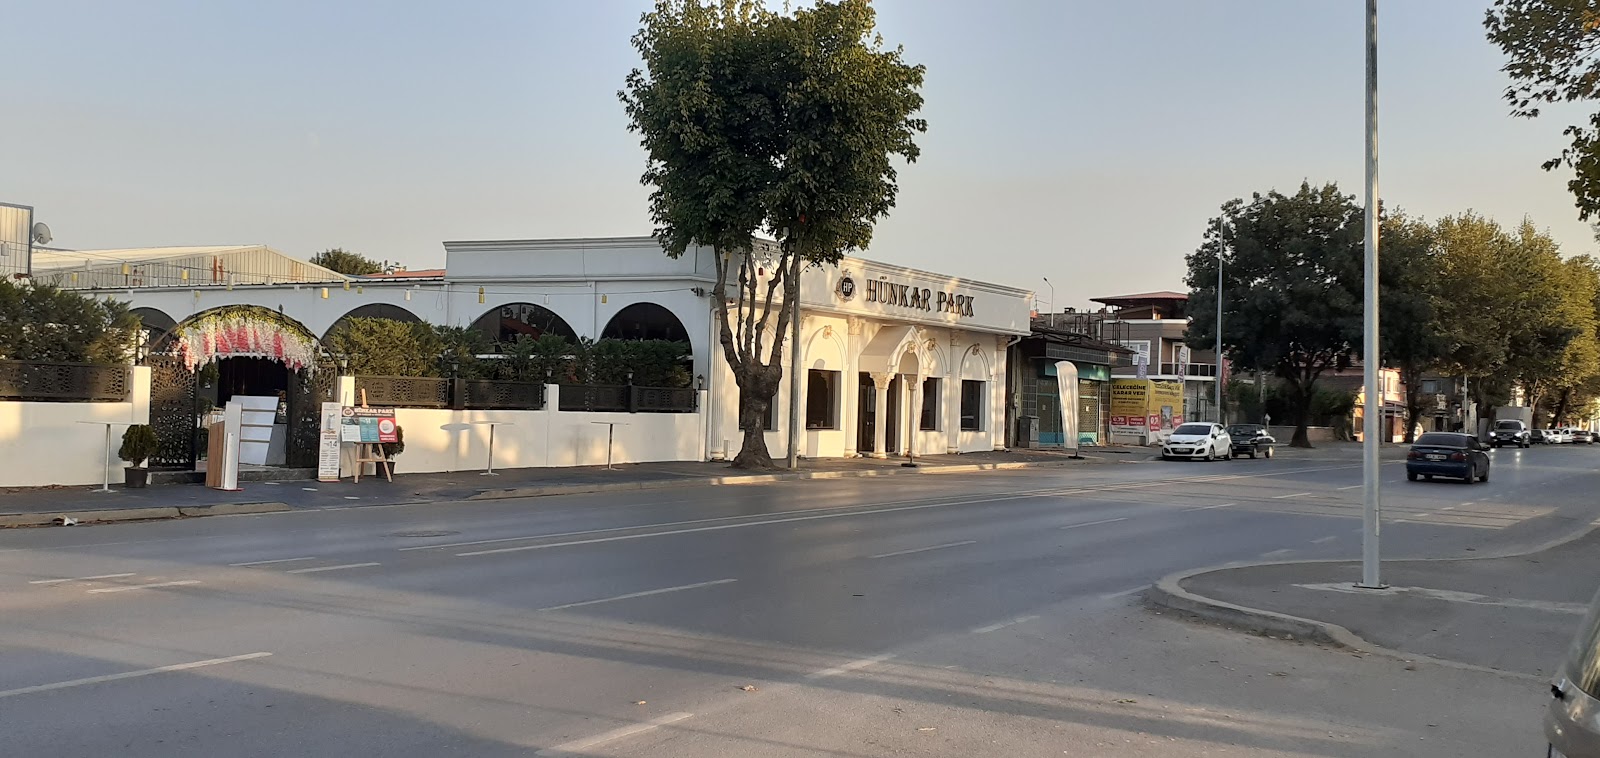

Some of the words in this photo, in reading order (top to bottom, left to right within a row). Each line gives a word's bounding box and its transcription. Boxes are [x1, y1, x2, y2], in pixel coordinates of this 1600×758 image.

[843, 282, 853, 292] HP
[866, 276, 931, 312] HÜNKAR
[936, 291, 975, 317] PARK
